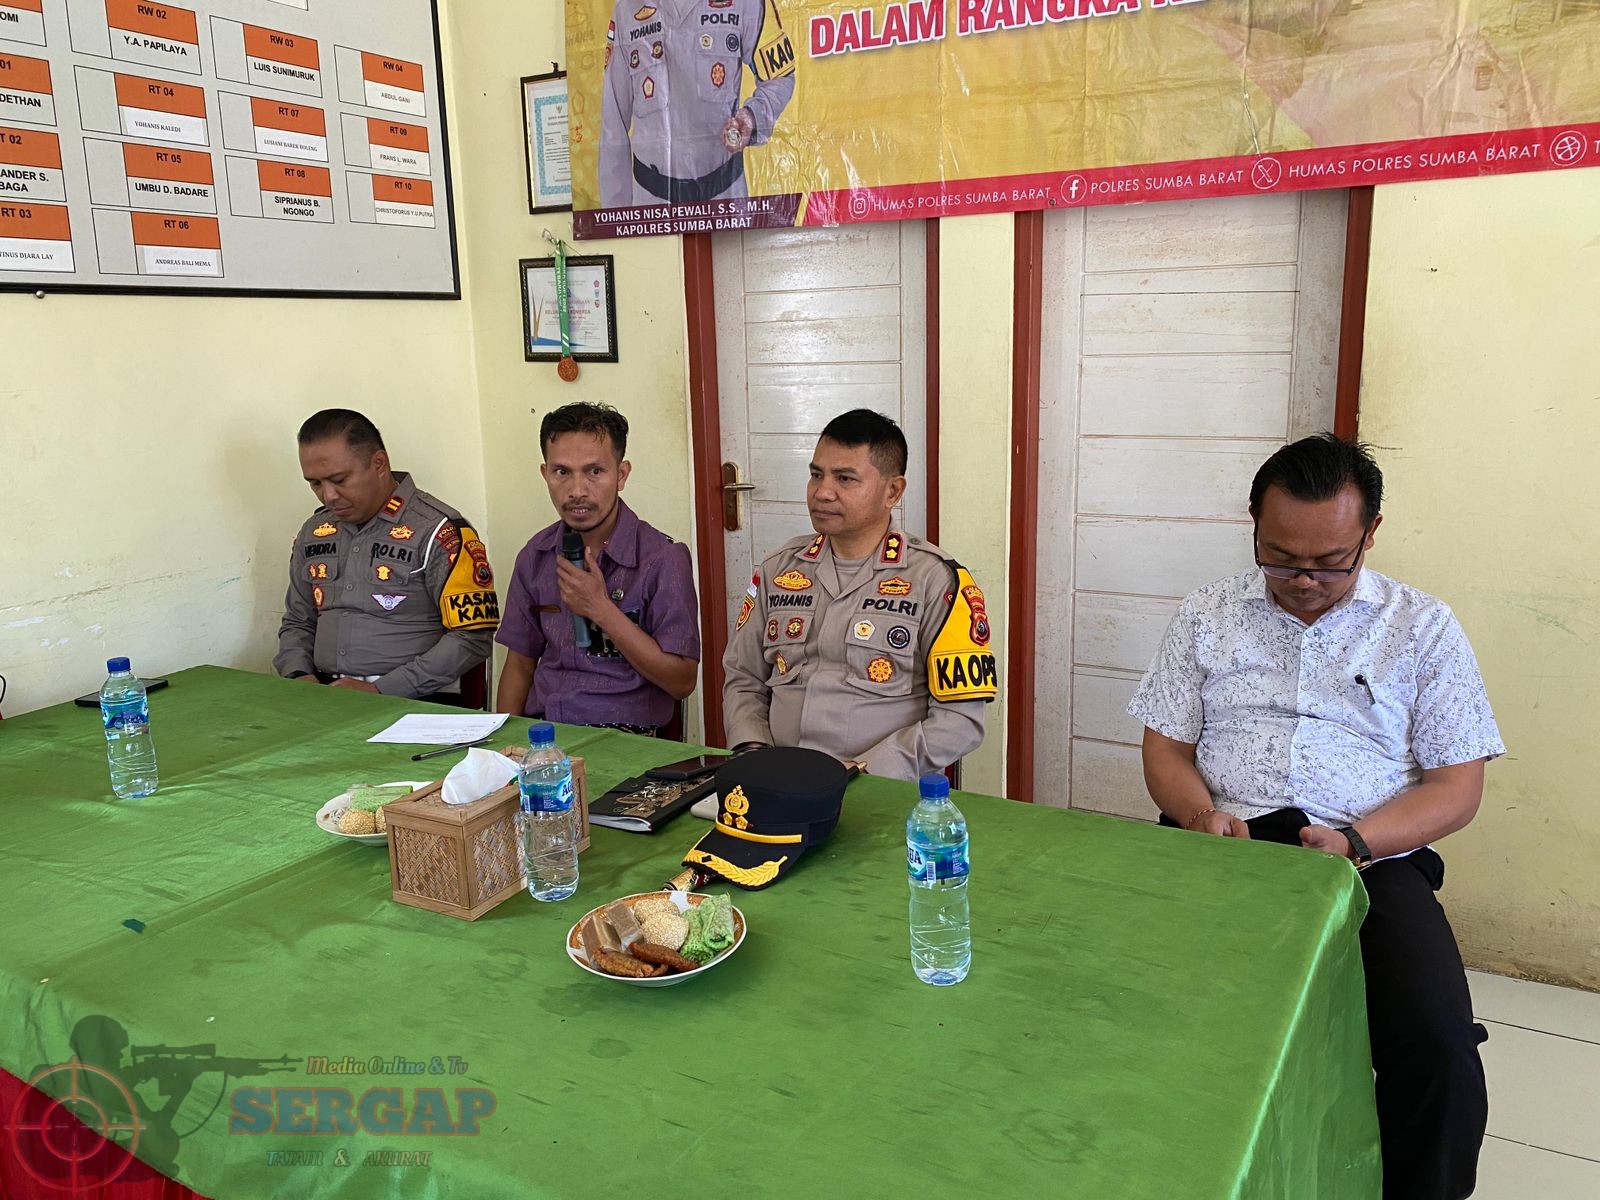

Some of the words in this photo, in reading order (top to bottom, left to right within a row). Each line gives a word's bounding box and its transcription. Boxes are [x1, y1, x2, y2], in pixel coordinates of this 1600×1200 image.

[137, 5, 153, 17] RW
[156, 9, 167, 20] 02
[701, 14, 739, 26] POLRI
[630, 21, 662, 41] YOHANIS
[809, 0, 945, 57] DALAM
[124, 36, 141, 47] Y.A.
[143, 40, 187, 56] PAPILAYA
[270, 35, 284, 46] RW
[285, 38, 294, 48] 03
[0, 60, 11, 70] 01
[383, 61, 394, 70] RW
[395, 64, 403, 72] 04
[254, 62, 271, 72] LUIS
[272, 66, 315, 82] SUNIMURUK
[148, 84, 161, 95] RT
[164, 87, 174, 97] 04
[0, 94, 41, 107] DETHAN
[279, 106, 289, 116] RT
[291, 109, 299, 118] 07
[135, 121, 159, 130] YOHANIS
[390, 126, 399, 134] RT
[399, 128, 407, 136] 09
[9, 135, 22, 144] 02
[156, 152, 168, 162] RT
[171, 154, 182, 164] 05
[380, 154, 396, 162] FRANS
[402, 157, 416, 165] WARA
[1289, 161, 1346, 178] HUMAS
[1353, 156, 1412, 173] POLRES
[1419, 150, 1478, 168] SUMBA
[1486, 144, 1541, 160] BARAT
[0, 169, 37, 180] ANDER
[39, 172, 48, 182] S.
[284, 168, 296, 177] RT
[297, 170, 306, 178] 08
[0, 182, 28, 192] BAGA
[394, 181, 404, 190] RT
[1091, 179, 1139, 194] POLRES
[1145, 175, 1194, 190] SUMBA
[1199, 170, 1243, 186] BARAT
[135, 182, 161, 193] UMBU
[164, 186, 172, 194] D.
[174, 186, 208, 198] BADARE
[274, 196, 312, 206] SIPRIANUS
[314, 199, 320, 208] B.
[874, 197, 914, 211] HUMAS
[918, 193, 961, 207] POLRES
[966, 190, 1008, 204] SUMBA
[1012, 187, 1050, 200] BARAT
[1, 208, 16, 218] RT
[19, 208, 32, 218] 03
[283, 207, 314, 217] NGONGO
[594, 208, 640, 224] YOHANIS
[643, 205, 670, 220] NISA
[672, 204, 715, 218] PEWALI,
[164, 220, 176, 228] RT
[178, 221, 190, 230] 06
[616, 221, 672, 236] KAPOLRES
[673, 218, 713, 233] SUMBA
[716, 216, 752, 230] BARAT
[304, 542, 337, 558] HENDRA
[370, 542, 412, 562] POLRI
[768, 594, 813, 608] YOHANIS
[862, 598, 918, 617] POLRI
